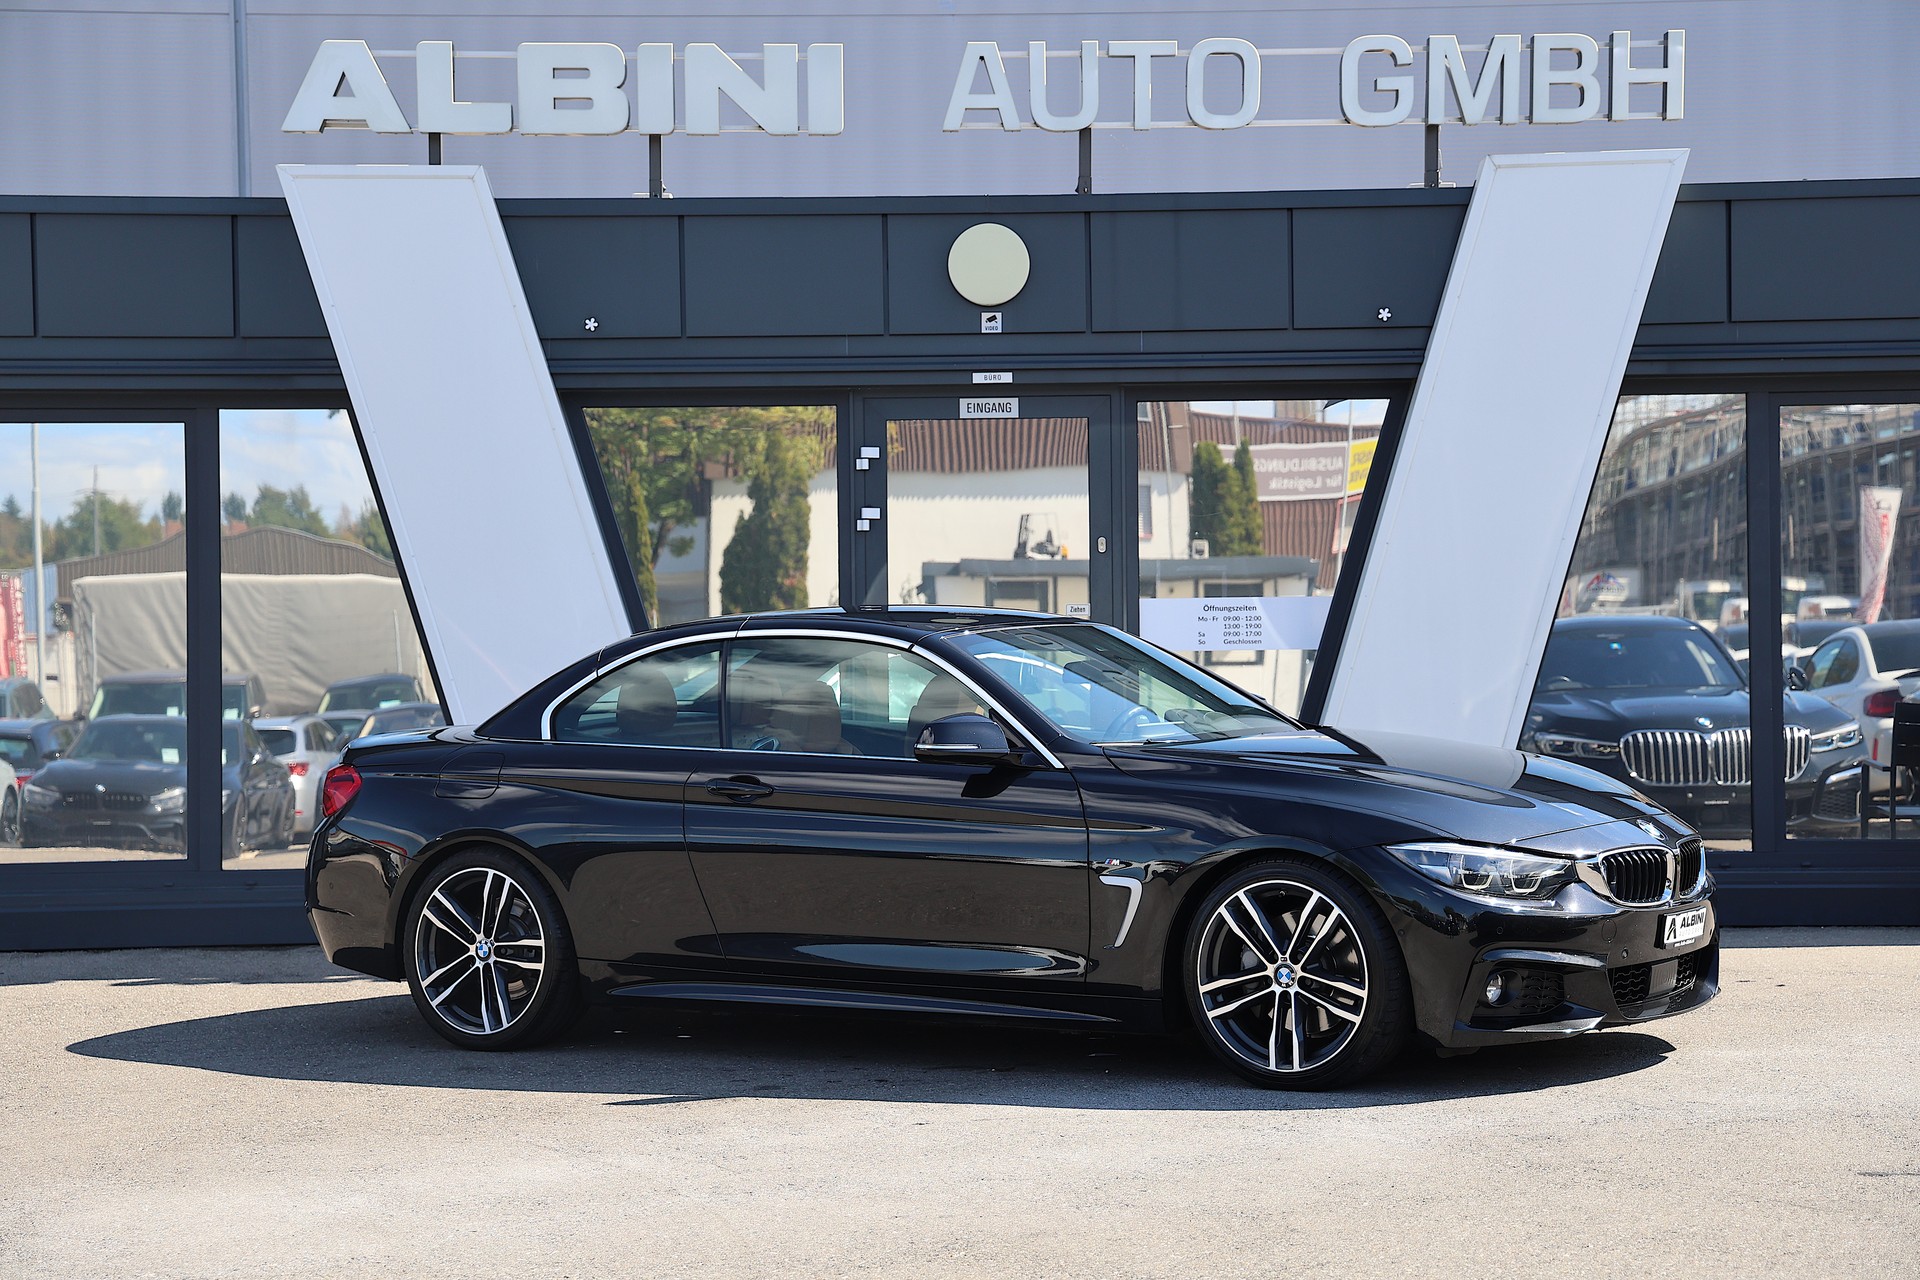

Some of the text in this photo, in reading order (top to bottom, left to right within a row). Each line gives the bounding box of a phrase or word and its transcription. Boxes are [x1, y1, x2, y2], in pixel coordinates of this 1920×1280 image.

[281, 29, 1686, 136] ALBINI AUTO GMBH
[966, 402, 1012, 414] EINGANG
[1203, 604, 1257, 613] Öffnungszeiten
